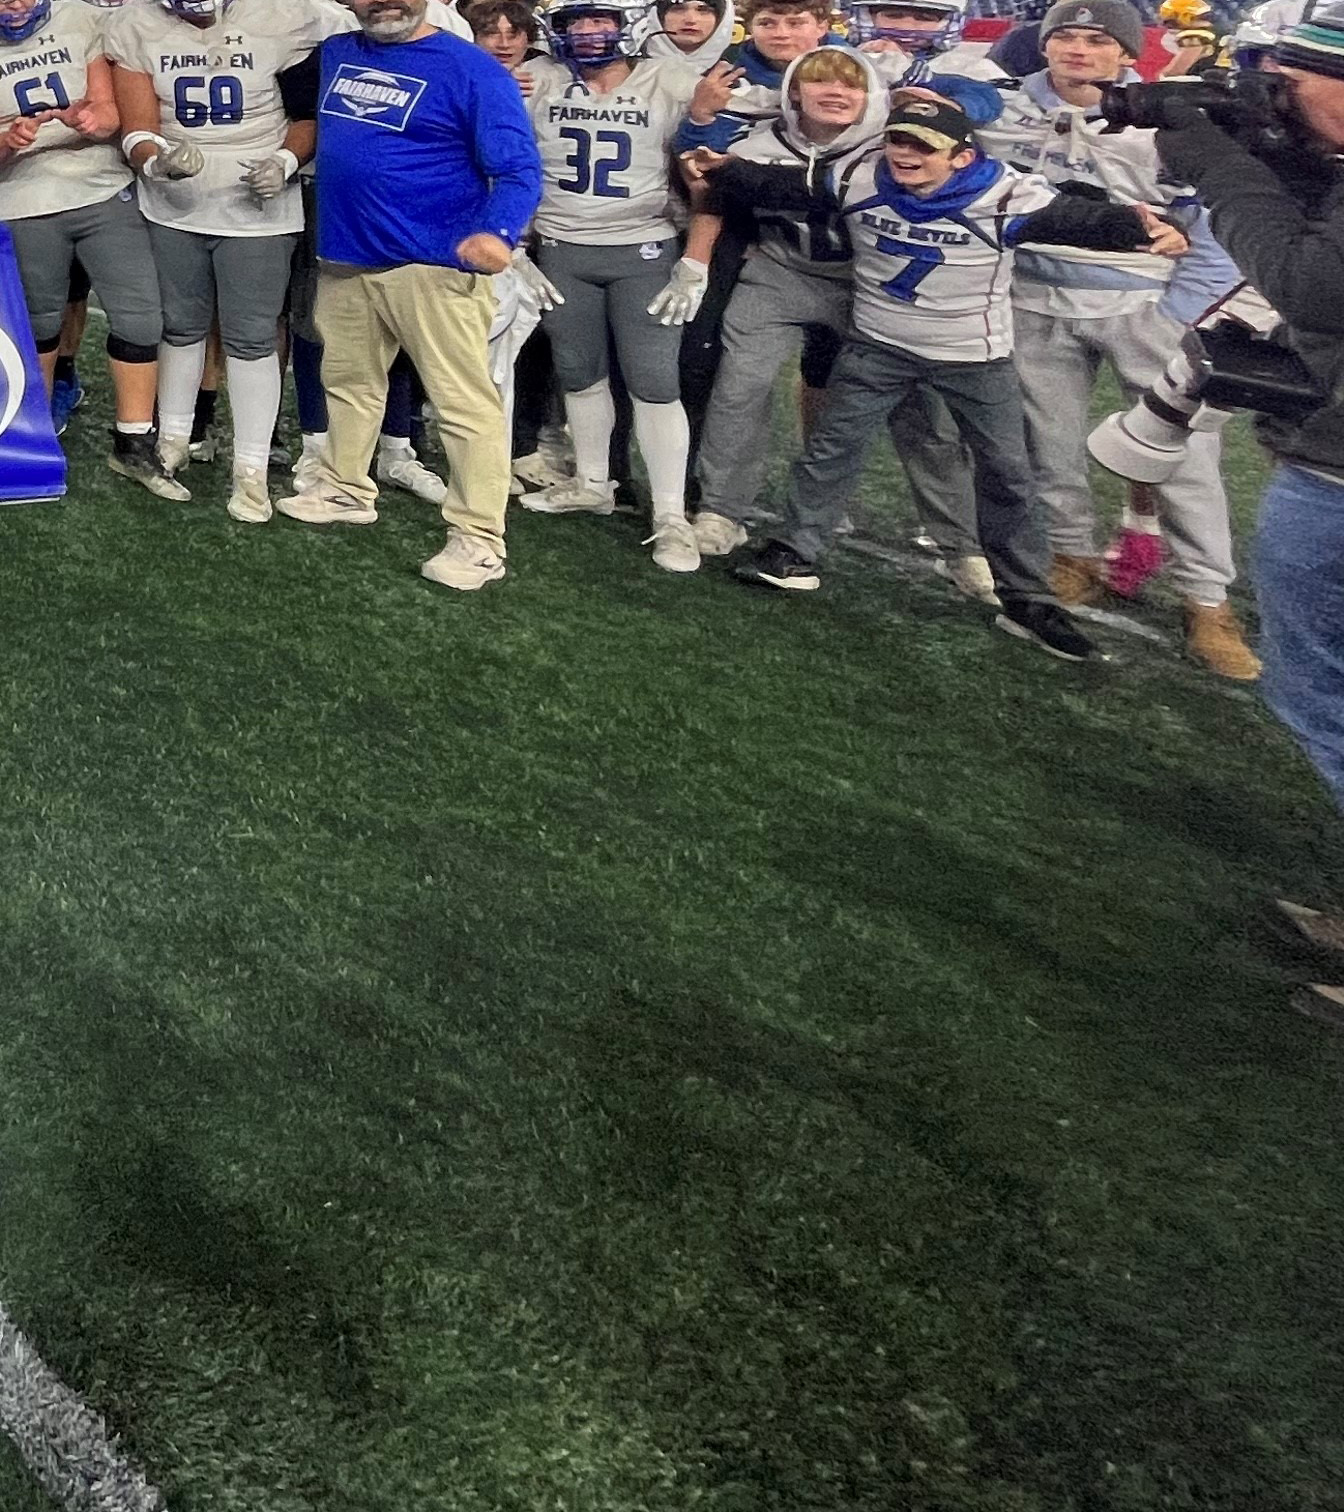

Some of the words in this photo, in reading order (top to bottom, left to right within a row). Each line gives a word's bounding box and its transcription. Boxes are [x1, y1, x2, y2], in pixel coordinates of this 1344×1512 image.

[160, 53, 253, 73] FAIRHEN
[333, 78, 411, 107] FAIRHAVEN
[549, 105, 649, 128] FAIRHAVEN
[558, 127, 632, 198] 32
[861, 213, 902, 236] BLUE
[907, 222, 971, 245] DEVILS
[874, 237, 945, 302] 7
